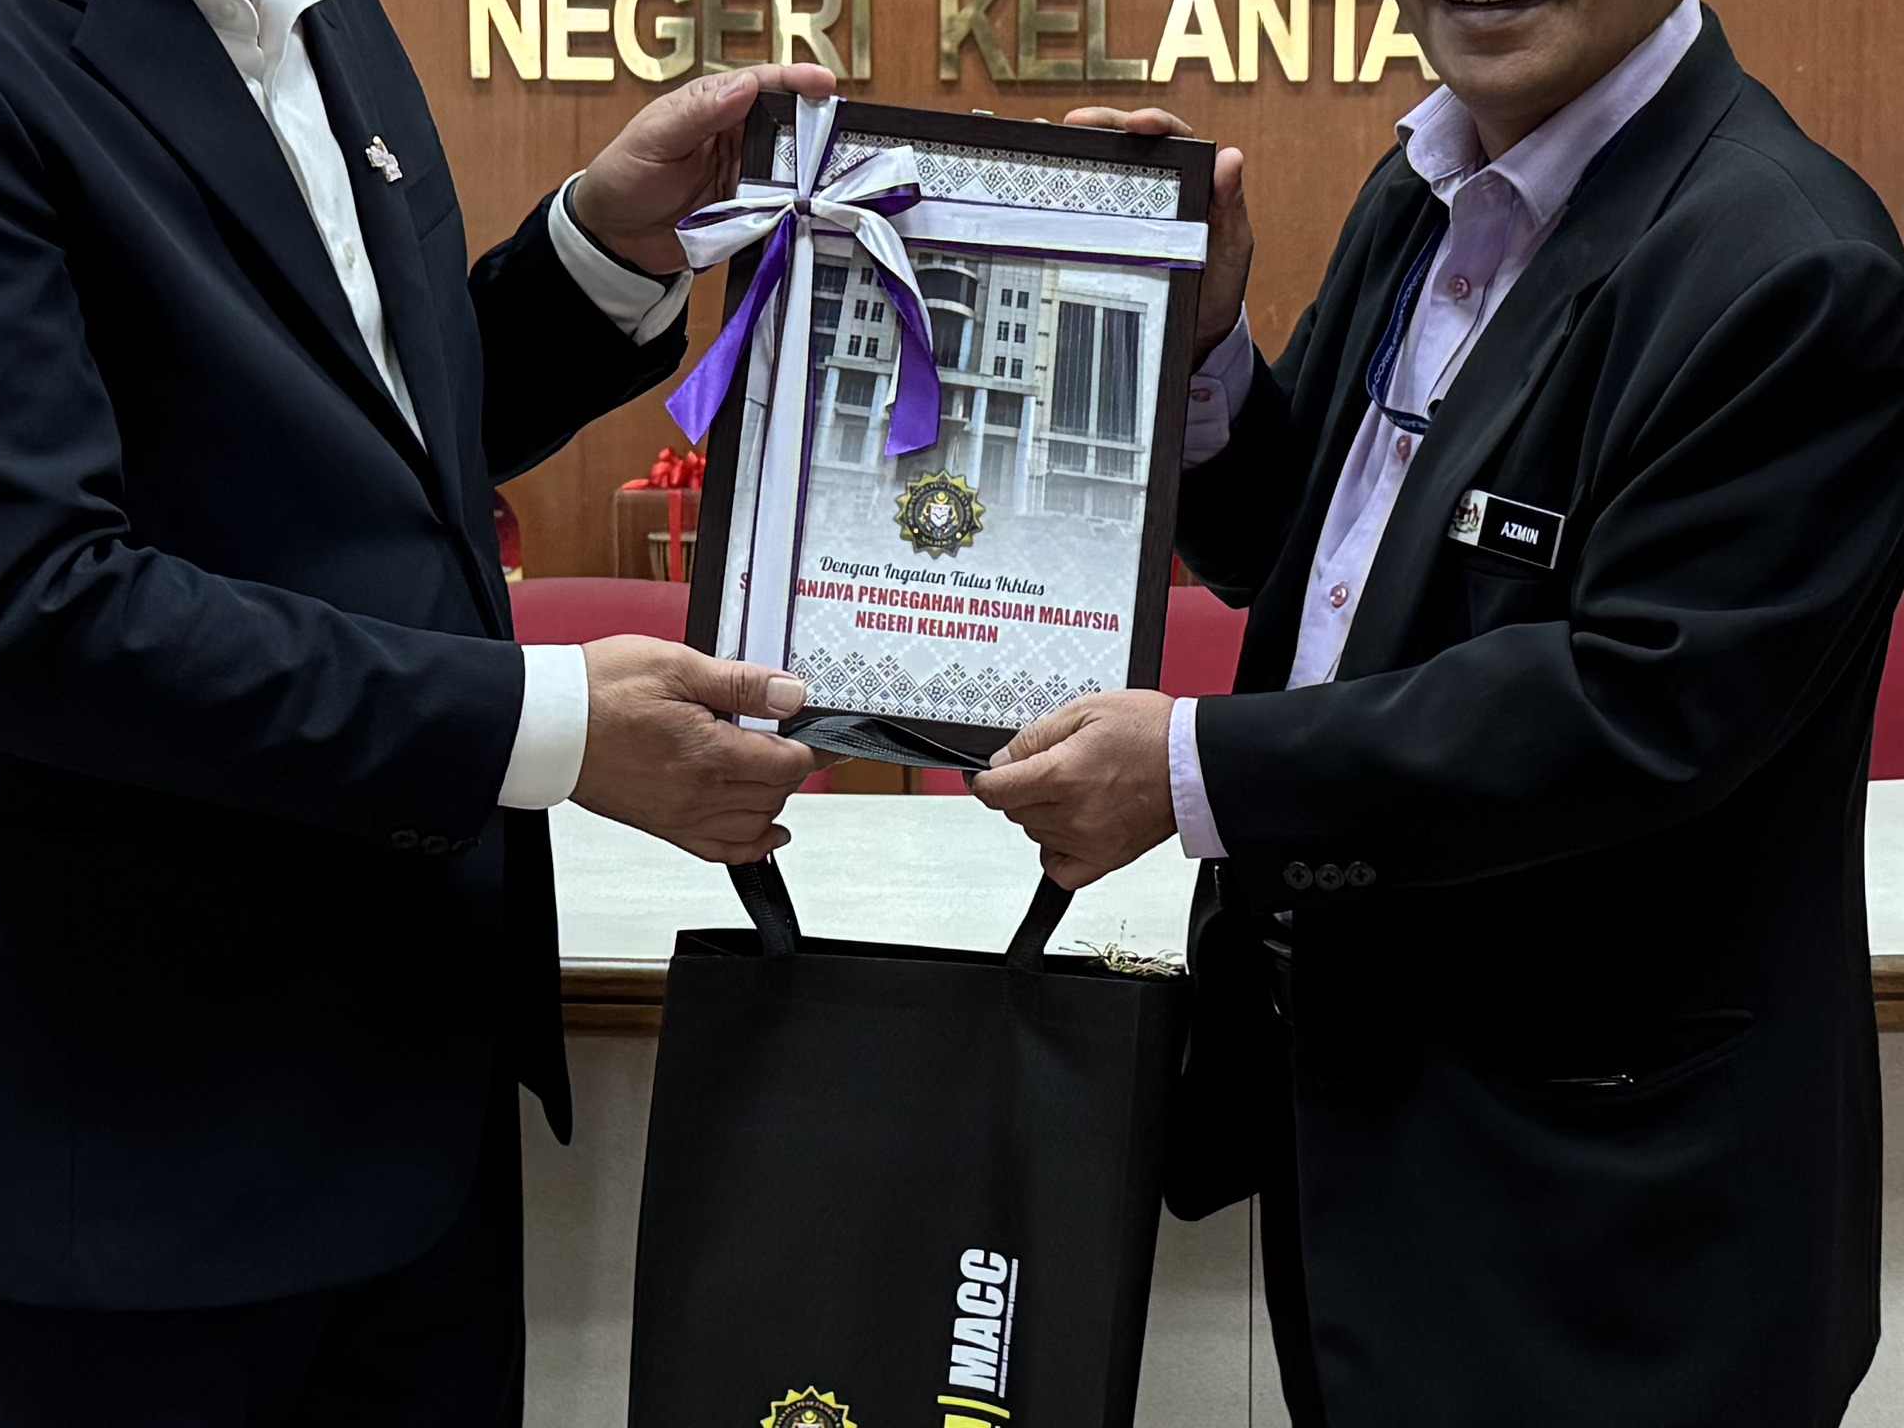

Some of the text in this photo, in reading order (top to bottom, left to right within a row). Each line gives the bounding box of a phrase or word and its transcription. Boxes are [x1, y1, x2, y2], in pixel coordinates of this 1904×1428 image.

[1500, 521, 1539, 545] AZMIN
[820, 555, 880, 580] Dengan
[994, 575, 1045, 596] Ikhlas
[855, 610, 999, 644] NEGERI KELANTAN
[857, 585, 965, 615] PENCEGAHAN
[968, 598, 1036, 623] RASUAH
[1038, 605, 1120, 632] MALAYSIA
[948, 1248, 1009, 1393] MACC
